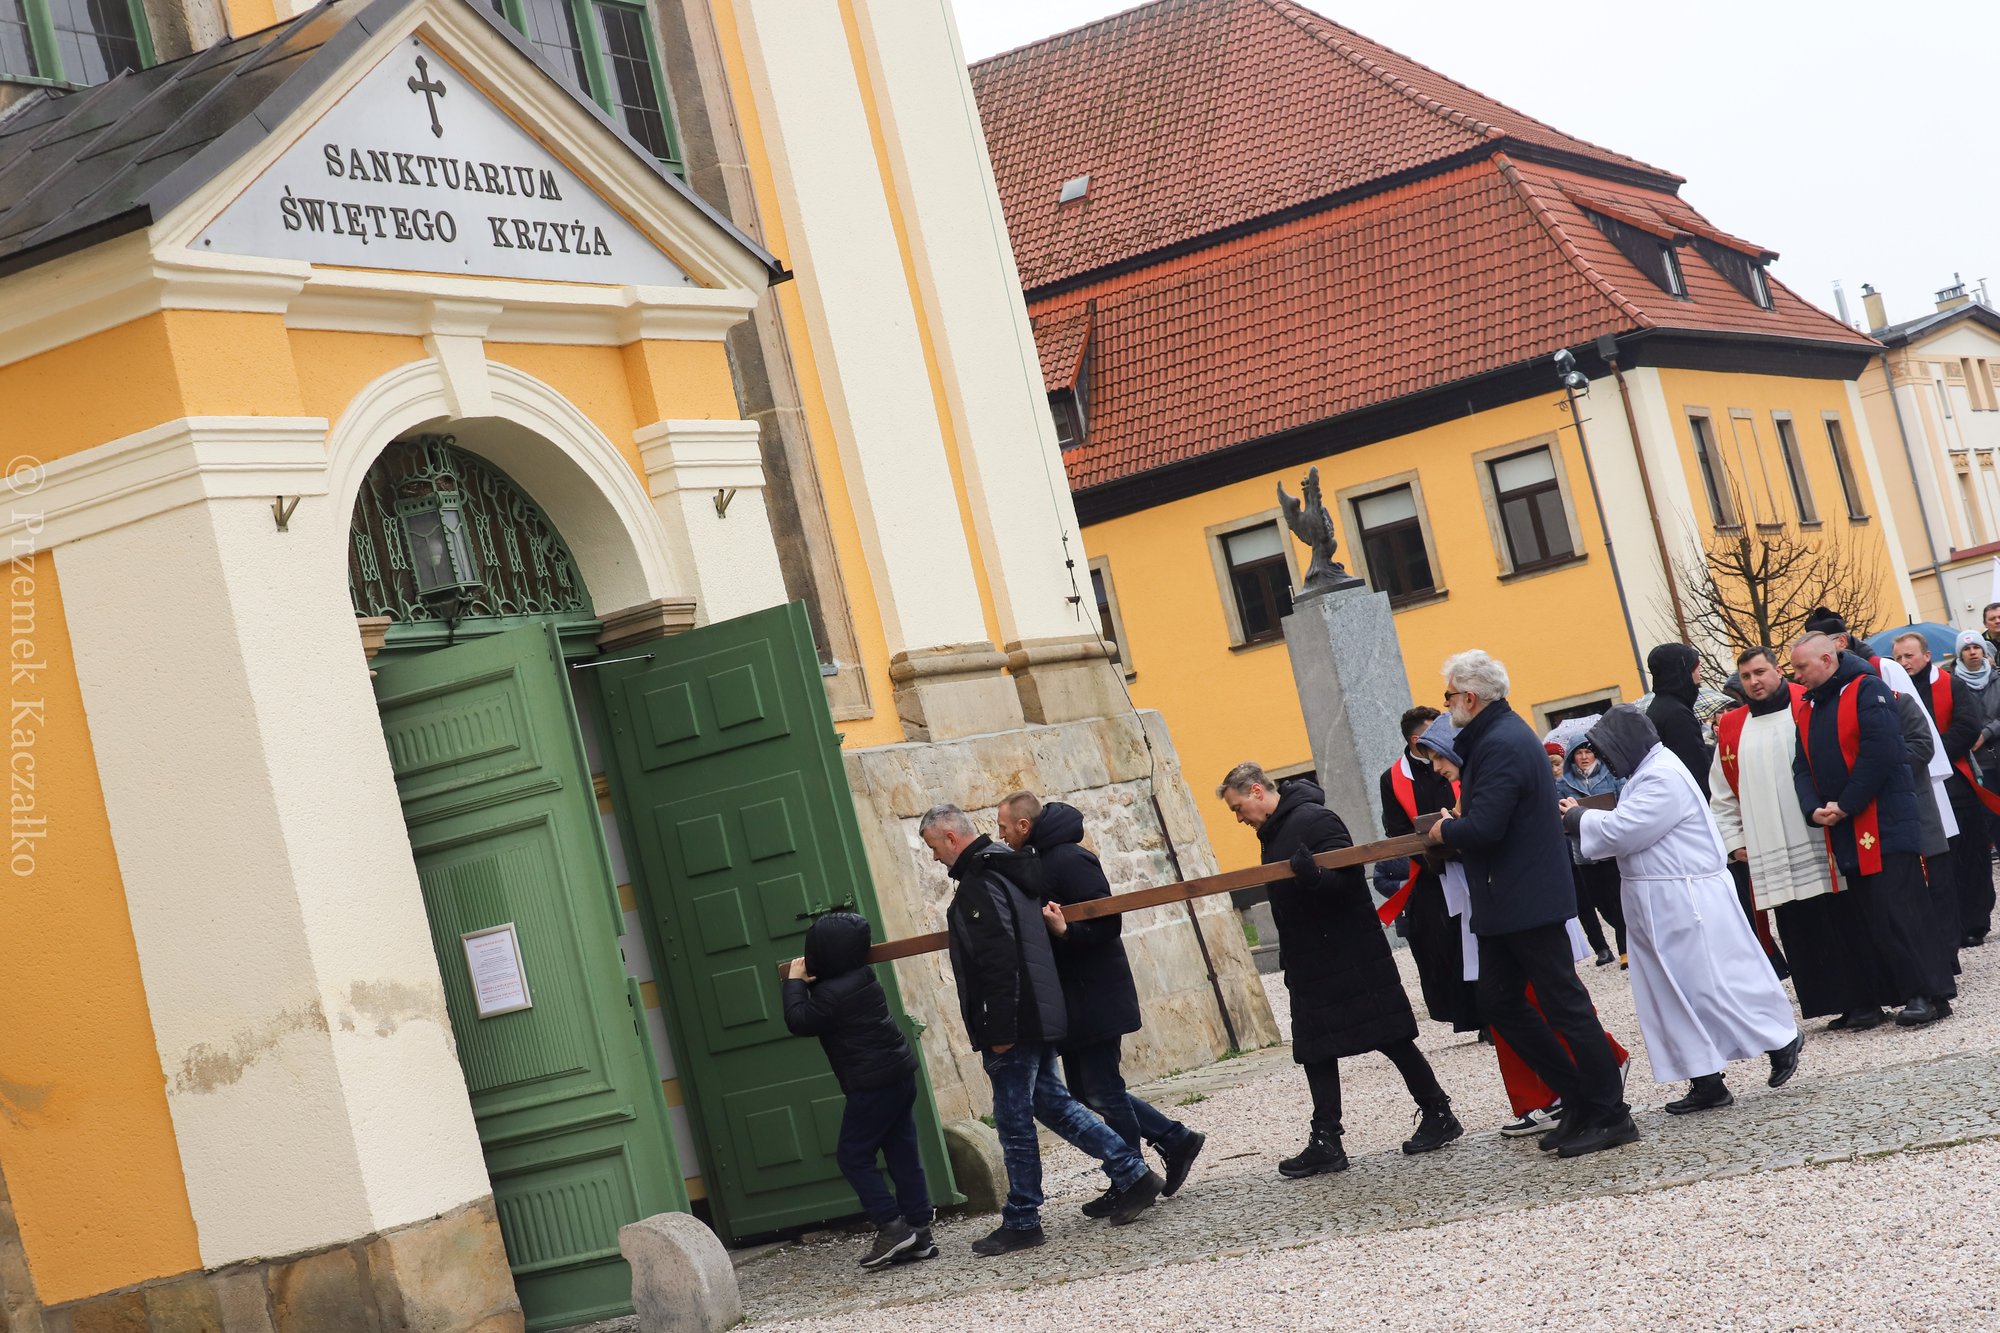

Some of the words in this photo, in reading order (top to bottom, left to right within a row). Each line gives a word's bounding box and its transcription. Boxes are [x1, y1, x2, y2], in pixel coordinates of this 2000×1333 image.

[324, 143, 563, 201] SANKTUARIUM
[279, 184, 457, 245] ŚWIĘTEGO
[487, 216, 612, 256] KRZYŻA
